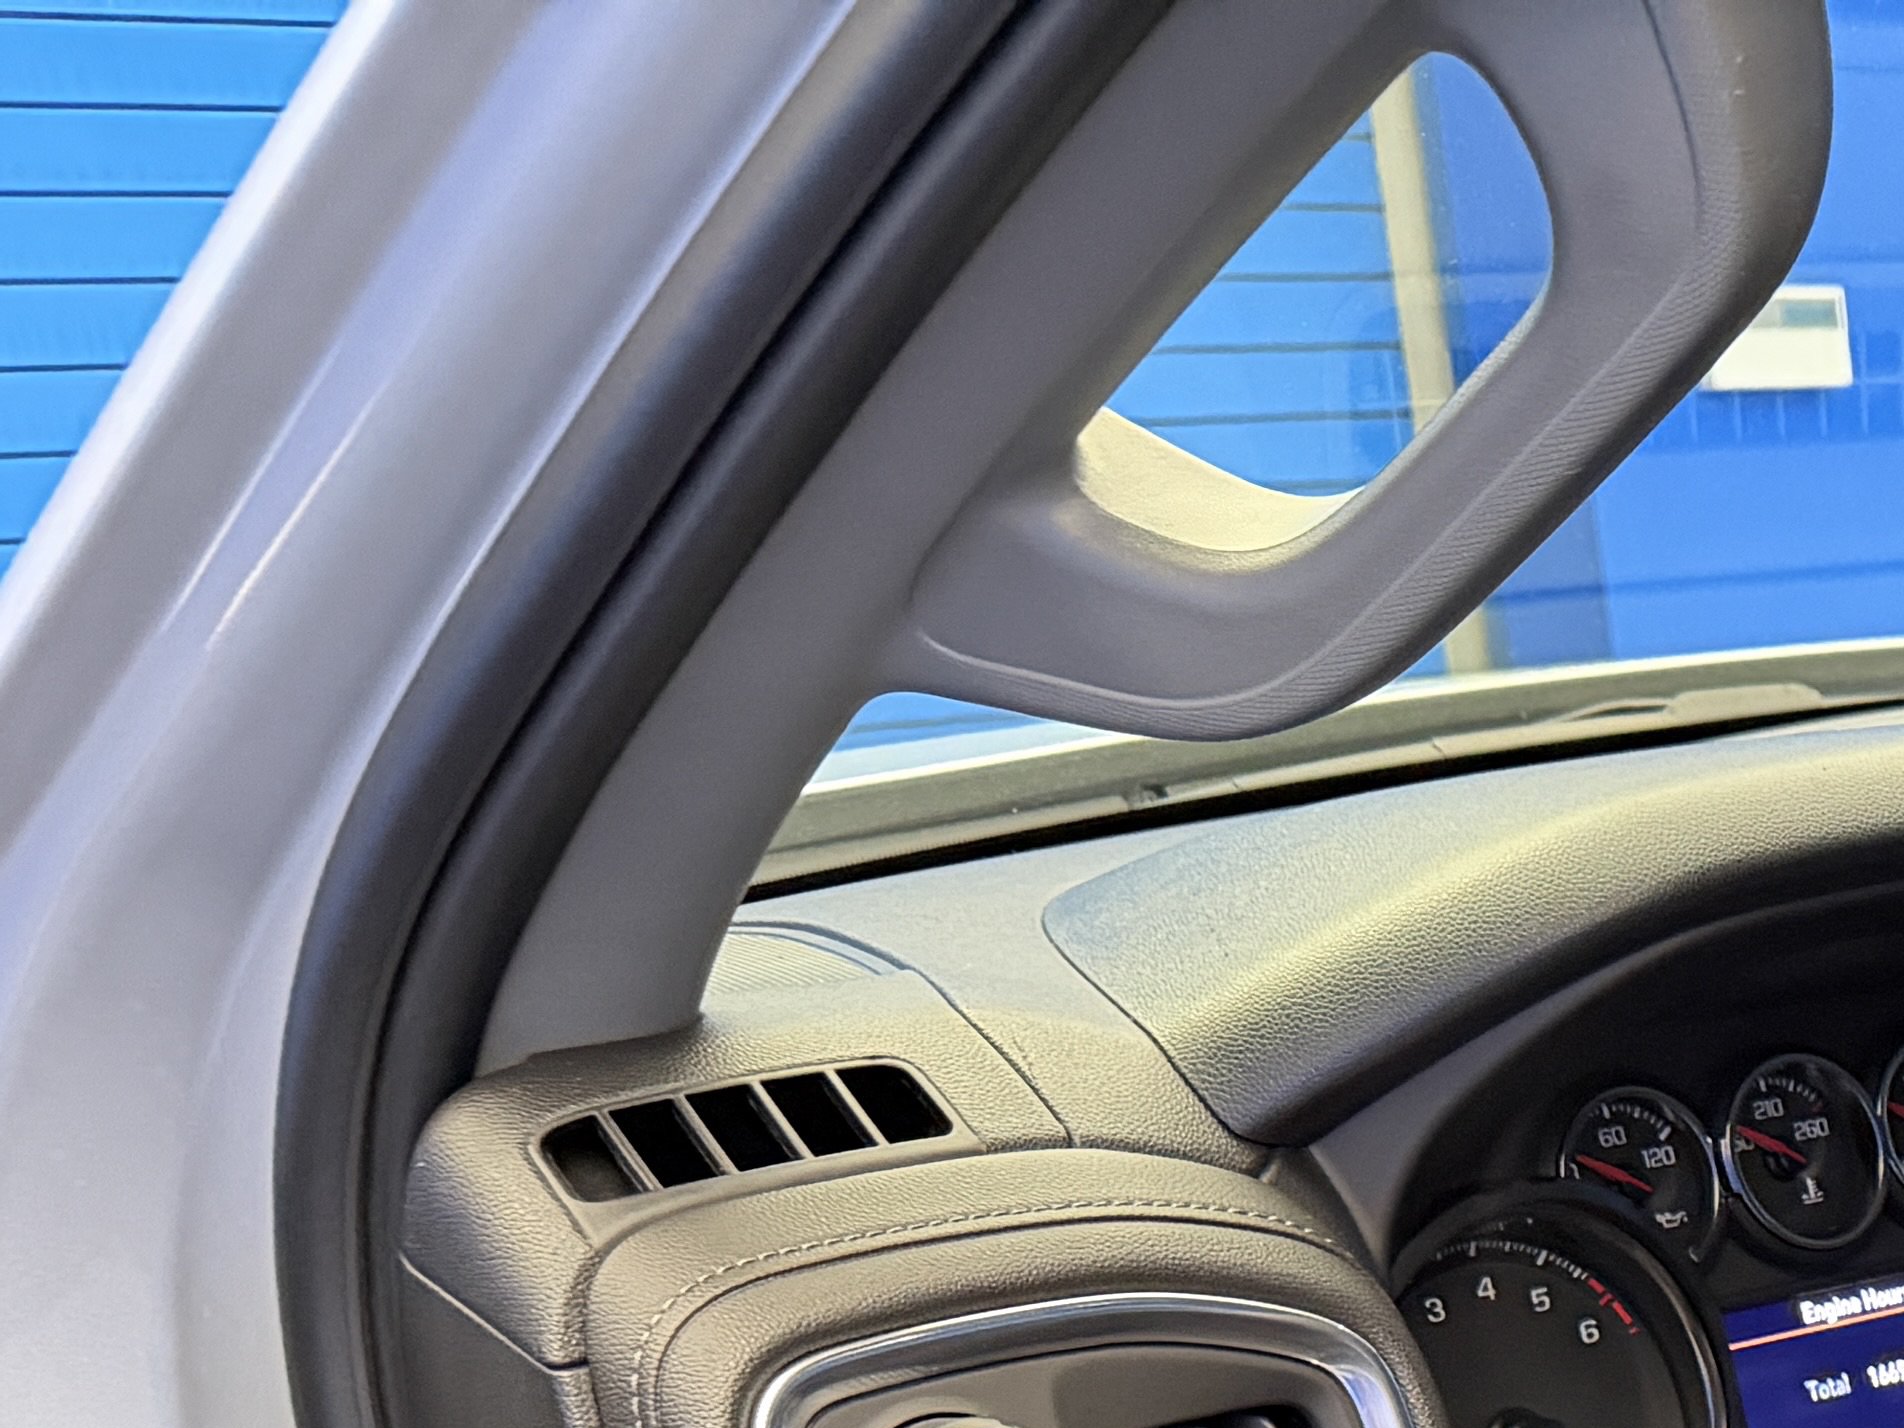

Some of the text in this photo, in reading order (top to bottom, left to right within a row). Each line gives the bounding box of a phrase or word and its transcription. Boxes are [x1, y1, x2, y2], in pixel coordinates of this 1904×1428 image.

[1753, 1097, 1784, 1121] 210
[1598, 1125, 1628, 1149] 60
[1793, 1117, 1831, 1142] 260
[1640, 1145, 1677, 1169] 120
[1476, 1275, 1497, 1301] 4
[1530, 1287, 1551, 1313] 5
[1424, 1297, 1447, 1323] 3
[1800, 1295, 1863, 1325] Engine
[1578, 1317, 1601, 1344] 6
[1803, 1371, 1852, 1403] Total
